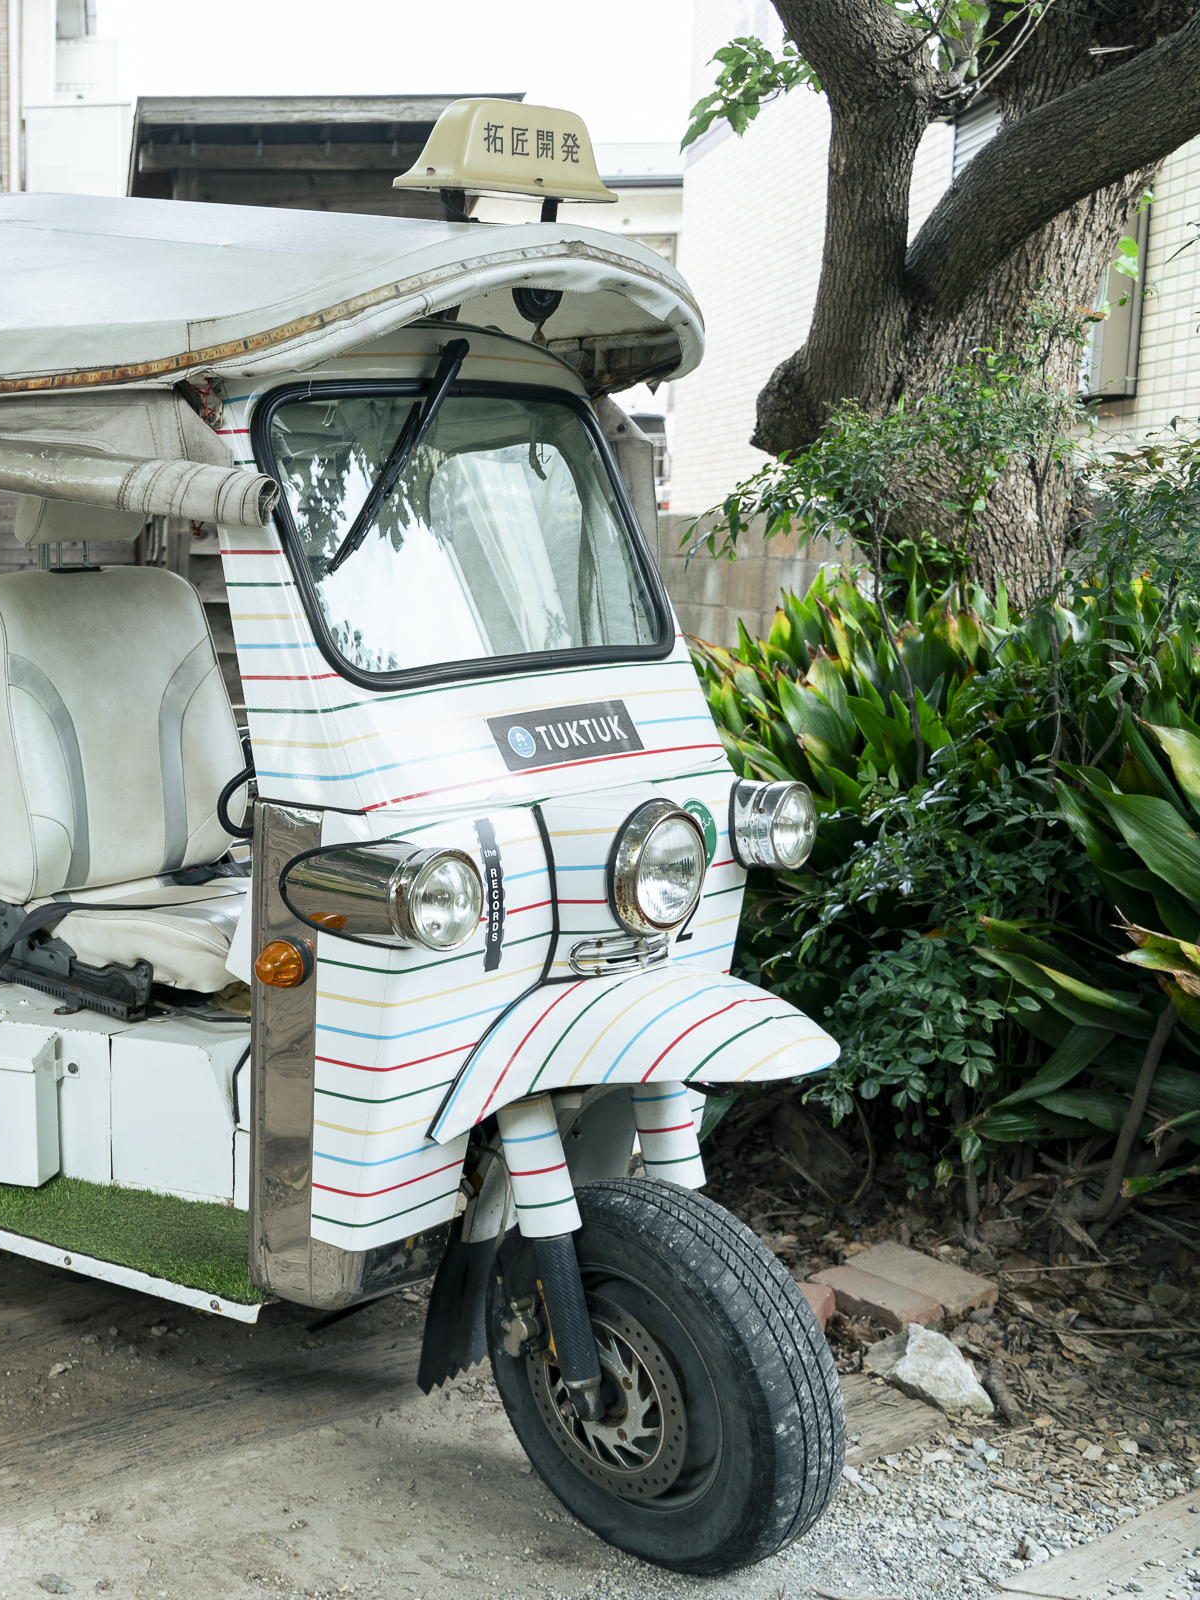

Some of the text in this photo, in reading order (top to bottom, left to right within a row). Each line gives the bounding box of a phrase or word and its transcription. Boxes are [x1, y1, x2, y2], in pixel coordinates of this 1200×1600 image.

[483, 121, 581, 163] 拓匠開発
[534, 715, 630, 752] TUKTUK
[484, 847, 501, 943] the RECORDS
